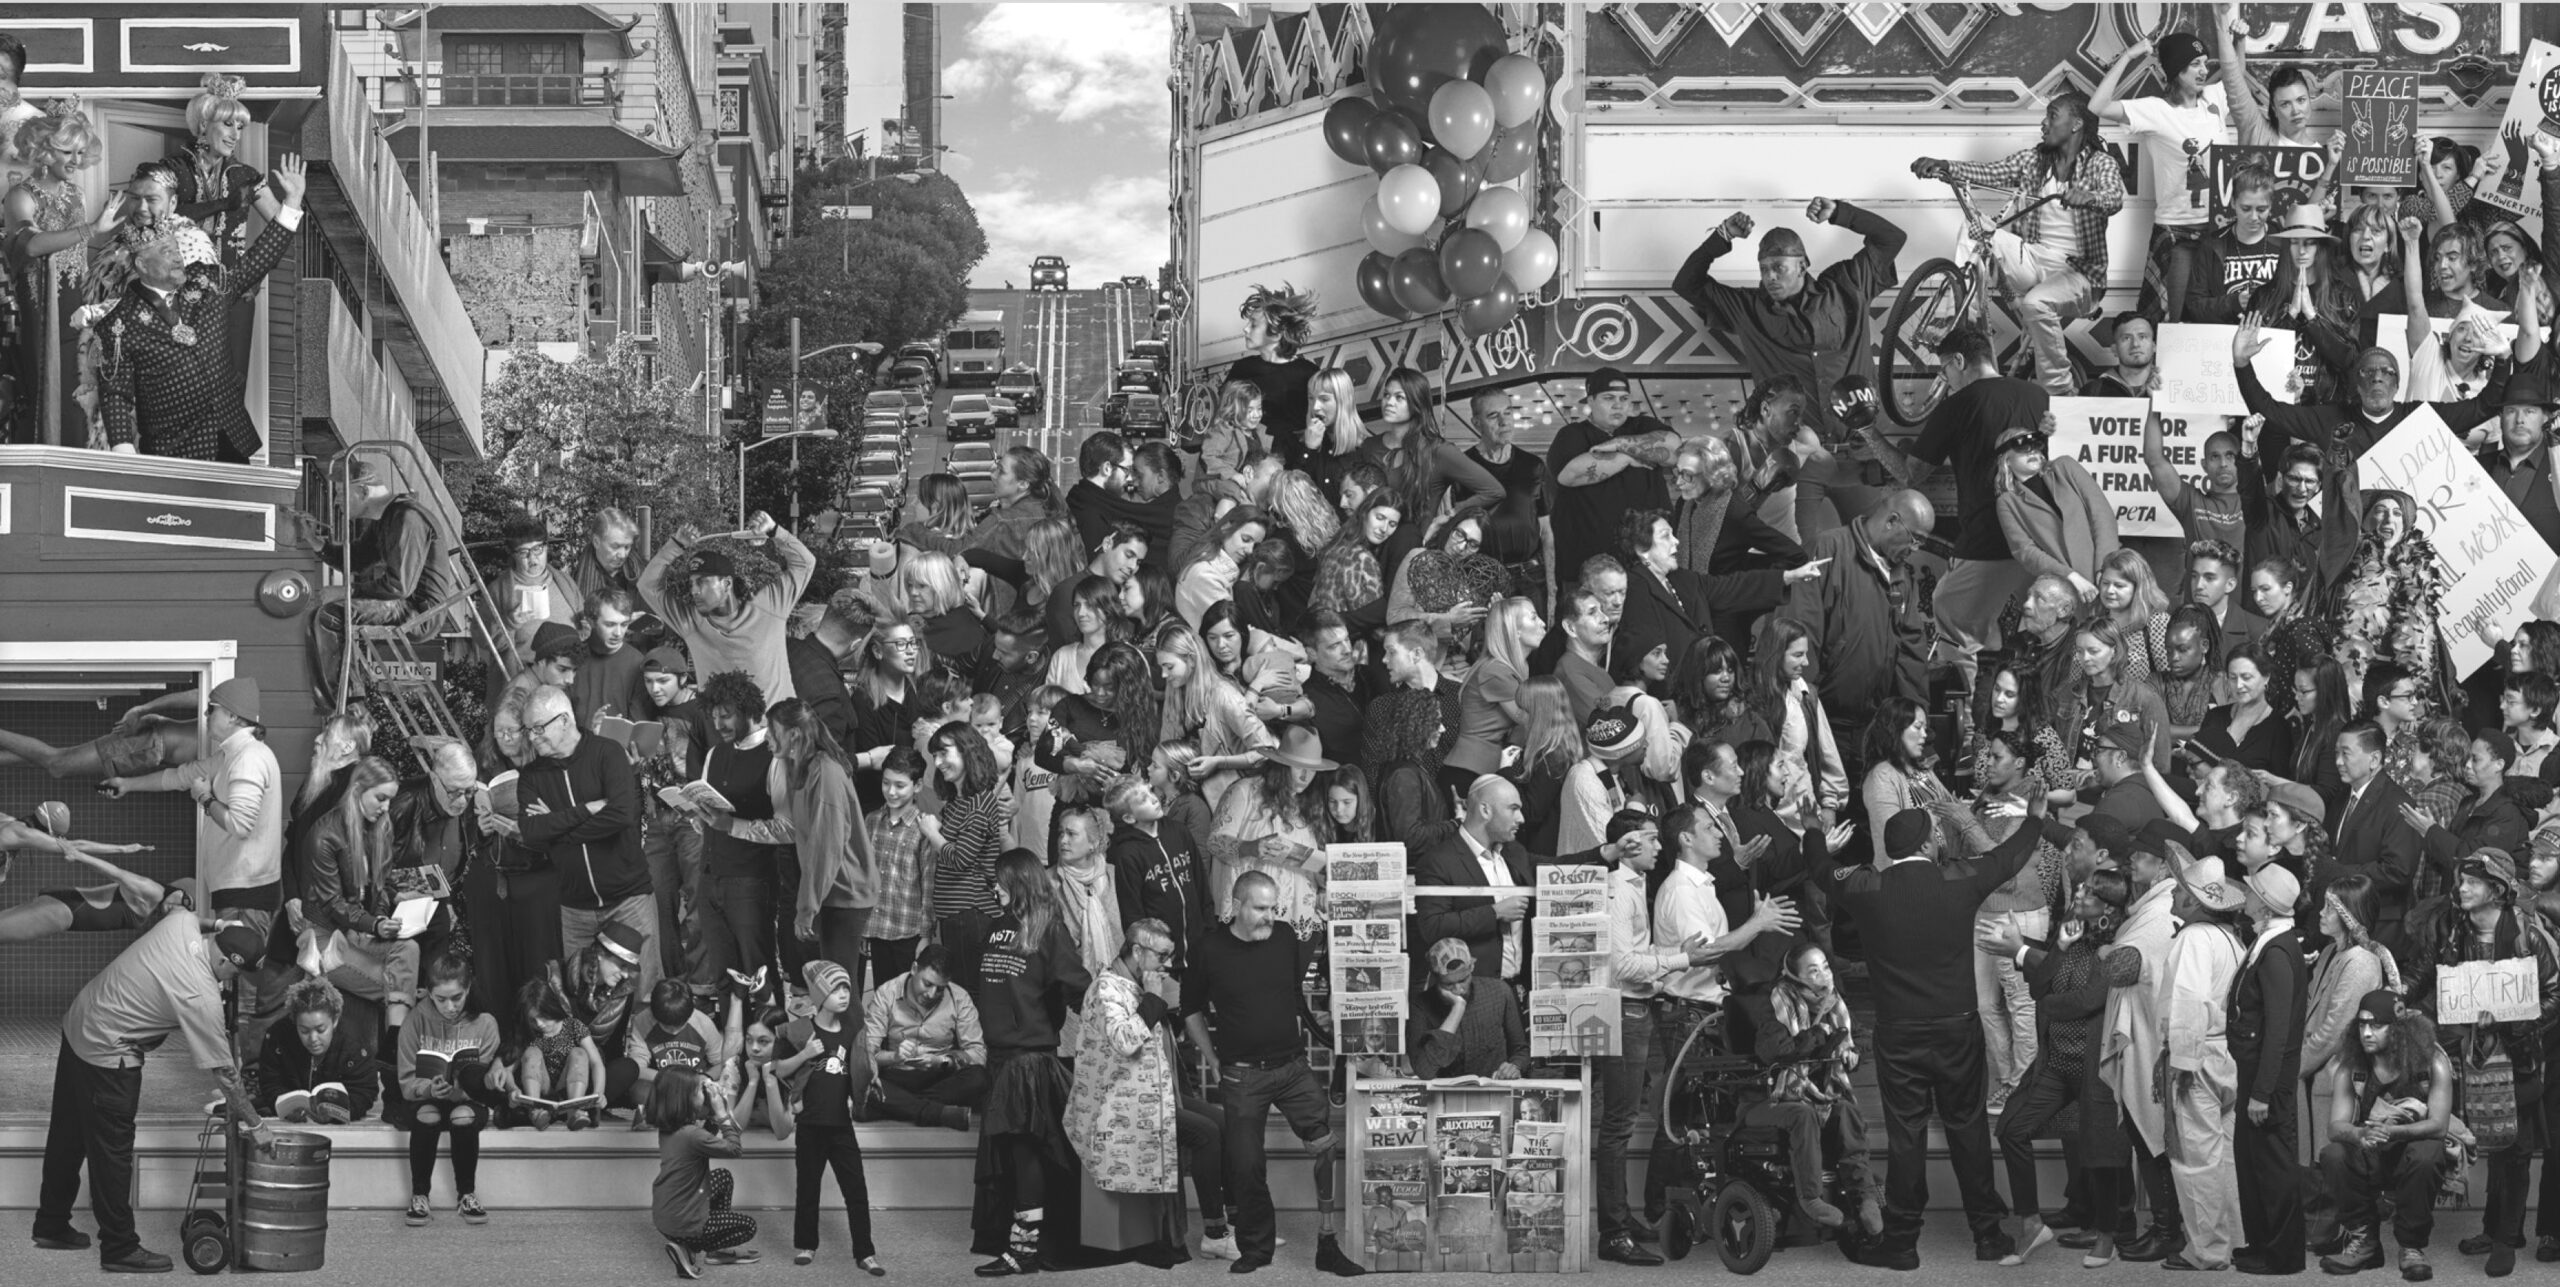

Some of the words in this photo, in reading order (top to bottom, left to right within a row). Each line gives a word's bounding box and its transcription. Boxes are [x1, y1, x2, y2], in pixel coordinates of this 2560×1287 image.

[2350, 74, 2414, 98] PEACE
[2217, 151, 2325, 207] WLD
[1832, 387, 1873, 417] NJM
[2089, 416, 2141, 436] VOTE
[2160, 418, 2187, 437] OR
[2078, 444, 2092, 463] A
[2098, 445, 2196, 465] FUR-REE
[2400, 428, 2457, 502] pay
[2416, 485, 2467, 540] OR
[2459, 495, 2527, 566] work
[1442, 1119, 1494, 1131] JUXTAPOZ
[1529, 1138, 1549, 1147] THE
